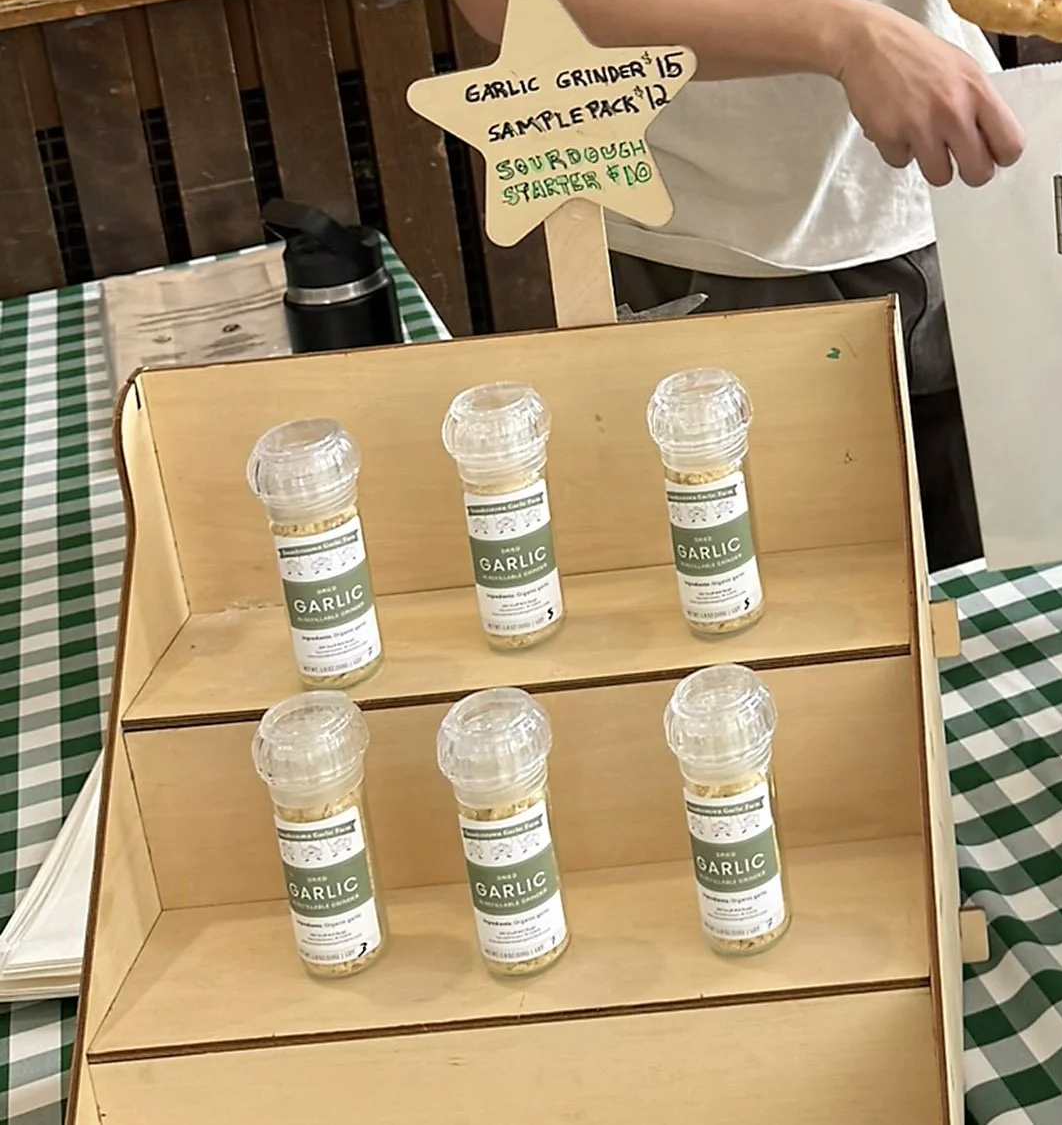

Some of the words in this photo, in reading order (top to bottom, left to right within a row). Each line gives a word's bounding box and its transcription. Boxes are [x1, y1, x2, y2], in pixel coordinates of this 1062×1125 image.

[465, 77, 540, 104] GARLIC
[556, 61, 647, 90] GRINDER
[641, 50, 684, 80] $15
[487, 106, 584, 143] SAMPLE
[585, 93, 641, 120] PACK
[634, 84, 672, 110] $12
[495, 139, 648, 181] SOURDOUGH
[501, 169, 603, 207] STARTER
[606, 161, 653, 187] $10
[479, 546, 546, 572] GARLIC
[677, 537, 741, 560] GARLIC
[294, 584, 363, 614] GARLIC
[696, 853, 765, 876] GARLIC
[288, 876, 359, 901] GARLIC
[476, 871, 547, 899] GARLIC
